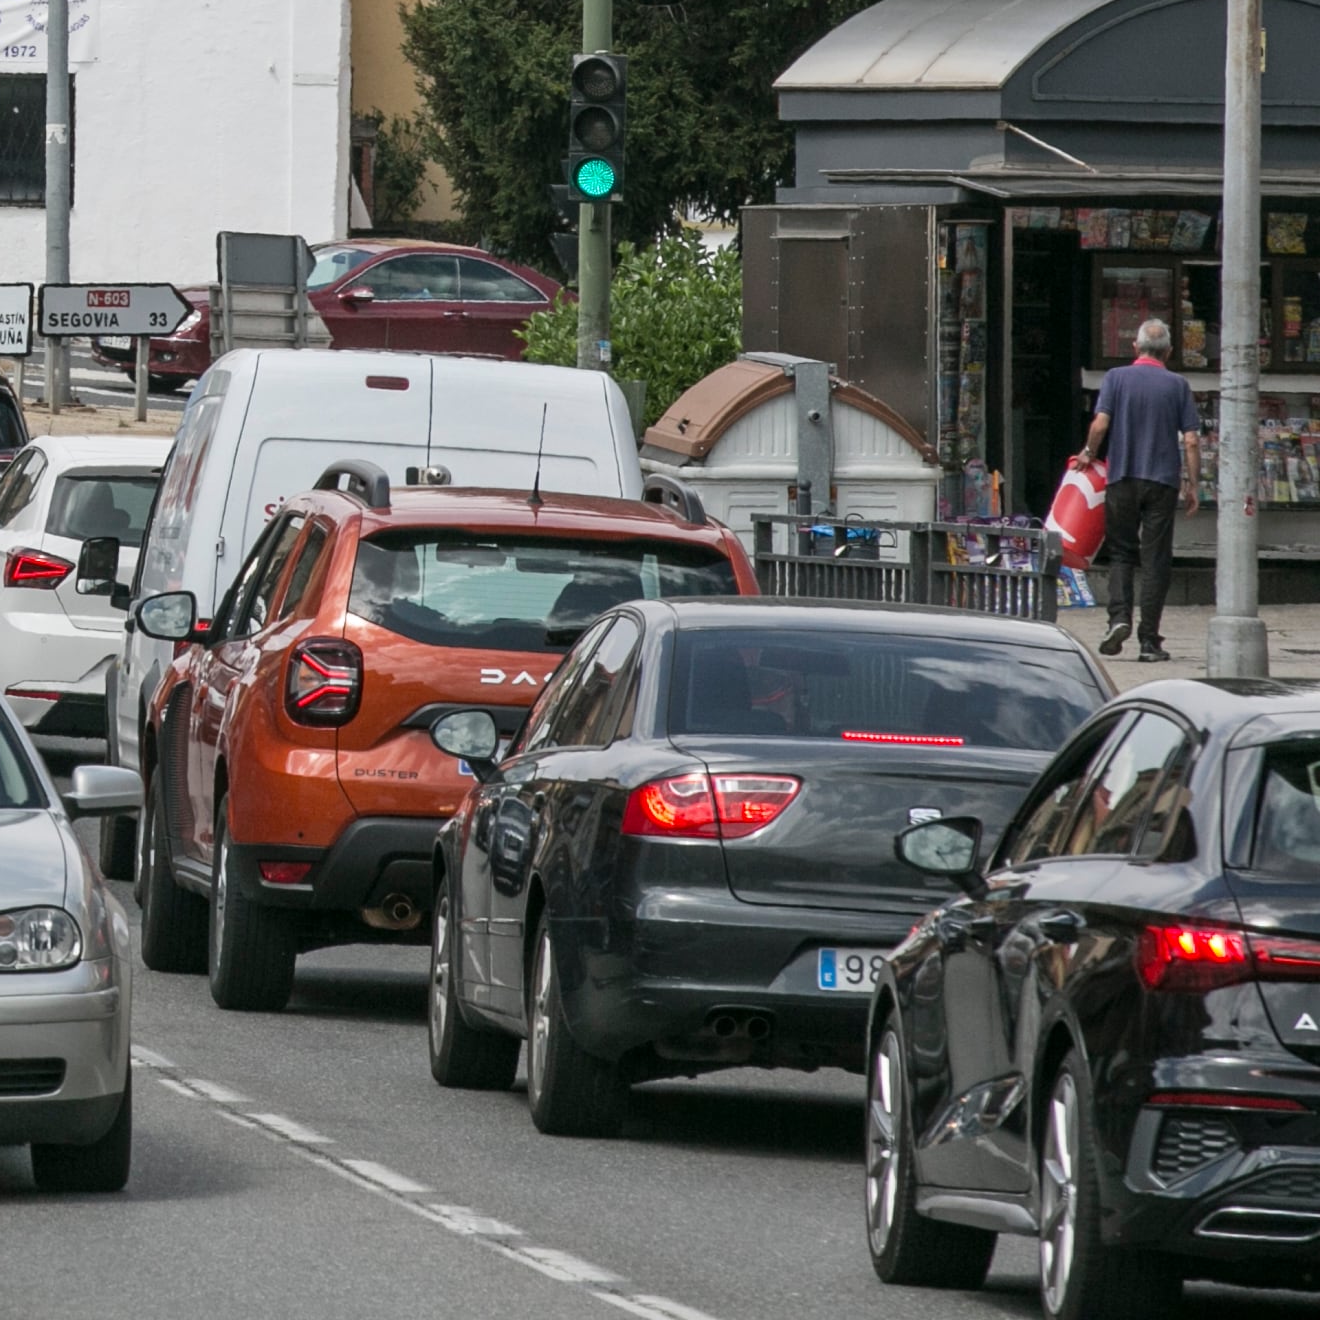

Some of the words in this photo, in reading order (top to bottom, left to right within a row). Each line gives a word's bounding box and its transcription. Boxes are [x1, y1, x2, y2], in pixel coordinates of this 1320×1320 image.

[3, 46, 37, 58] 1972
[88, 291, 129, 306] N-603
[48, 312, 120, 328] SEGOVIA
[149, 312, 168, 327] 33
[480, 668, 553, 686] DA
[354, 767, 419, 780] DUSTER
